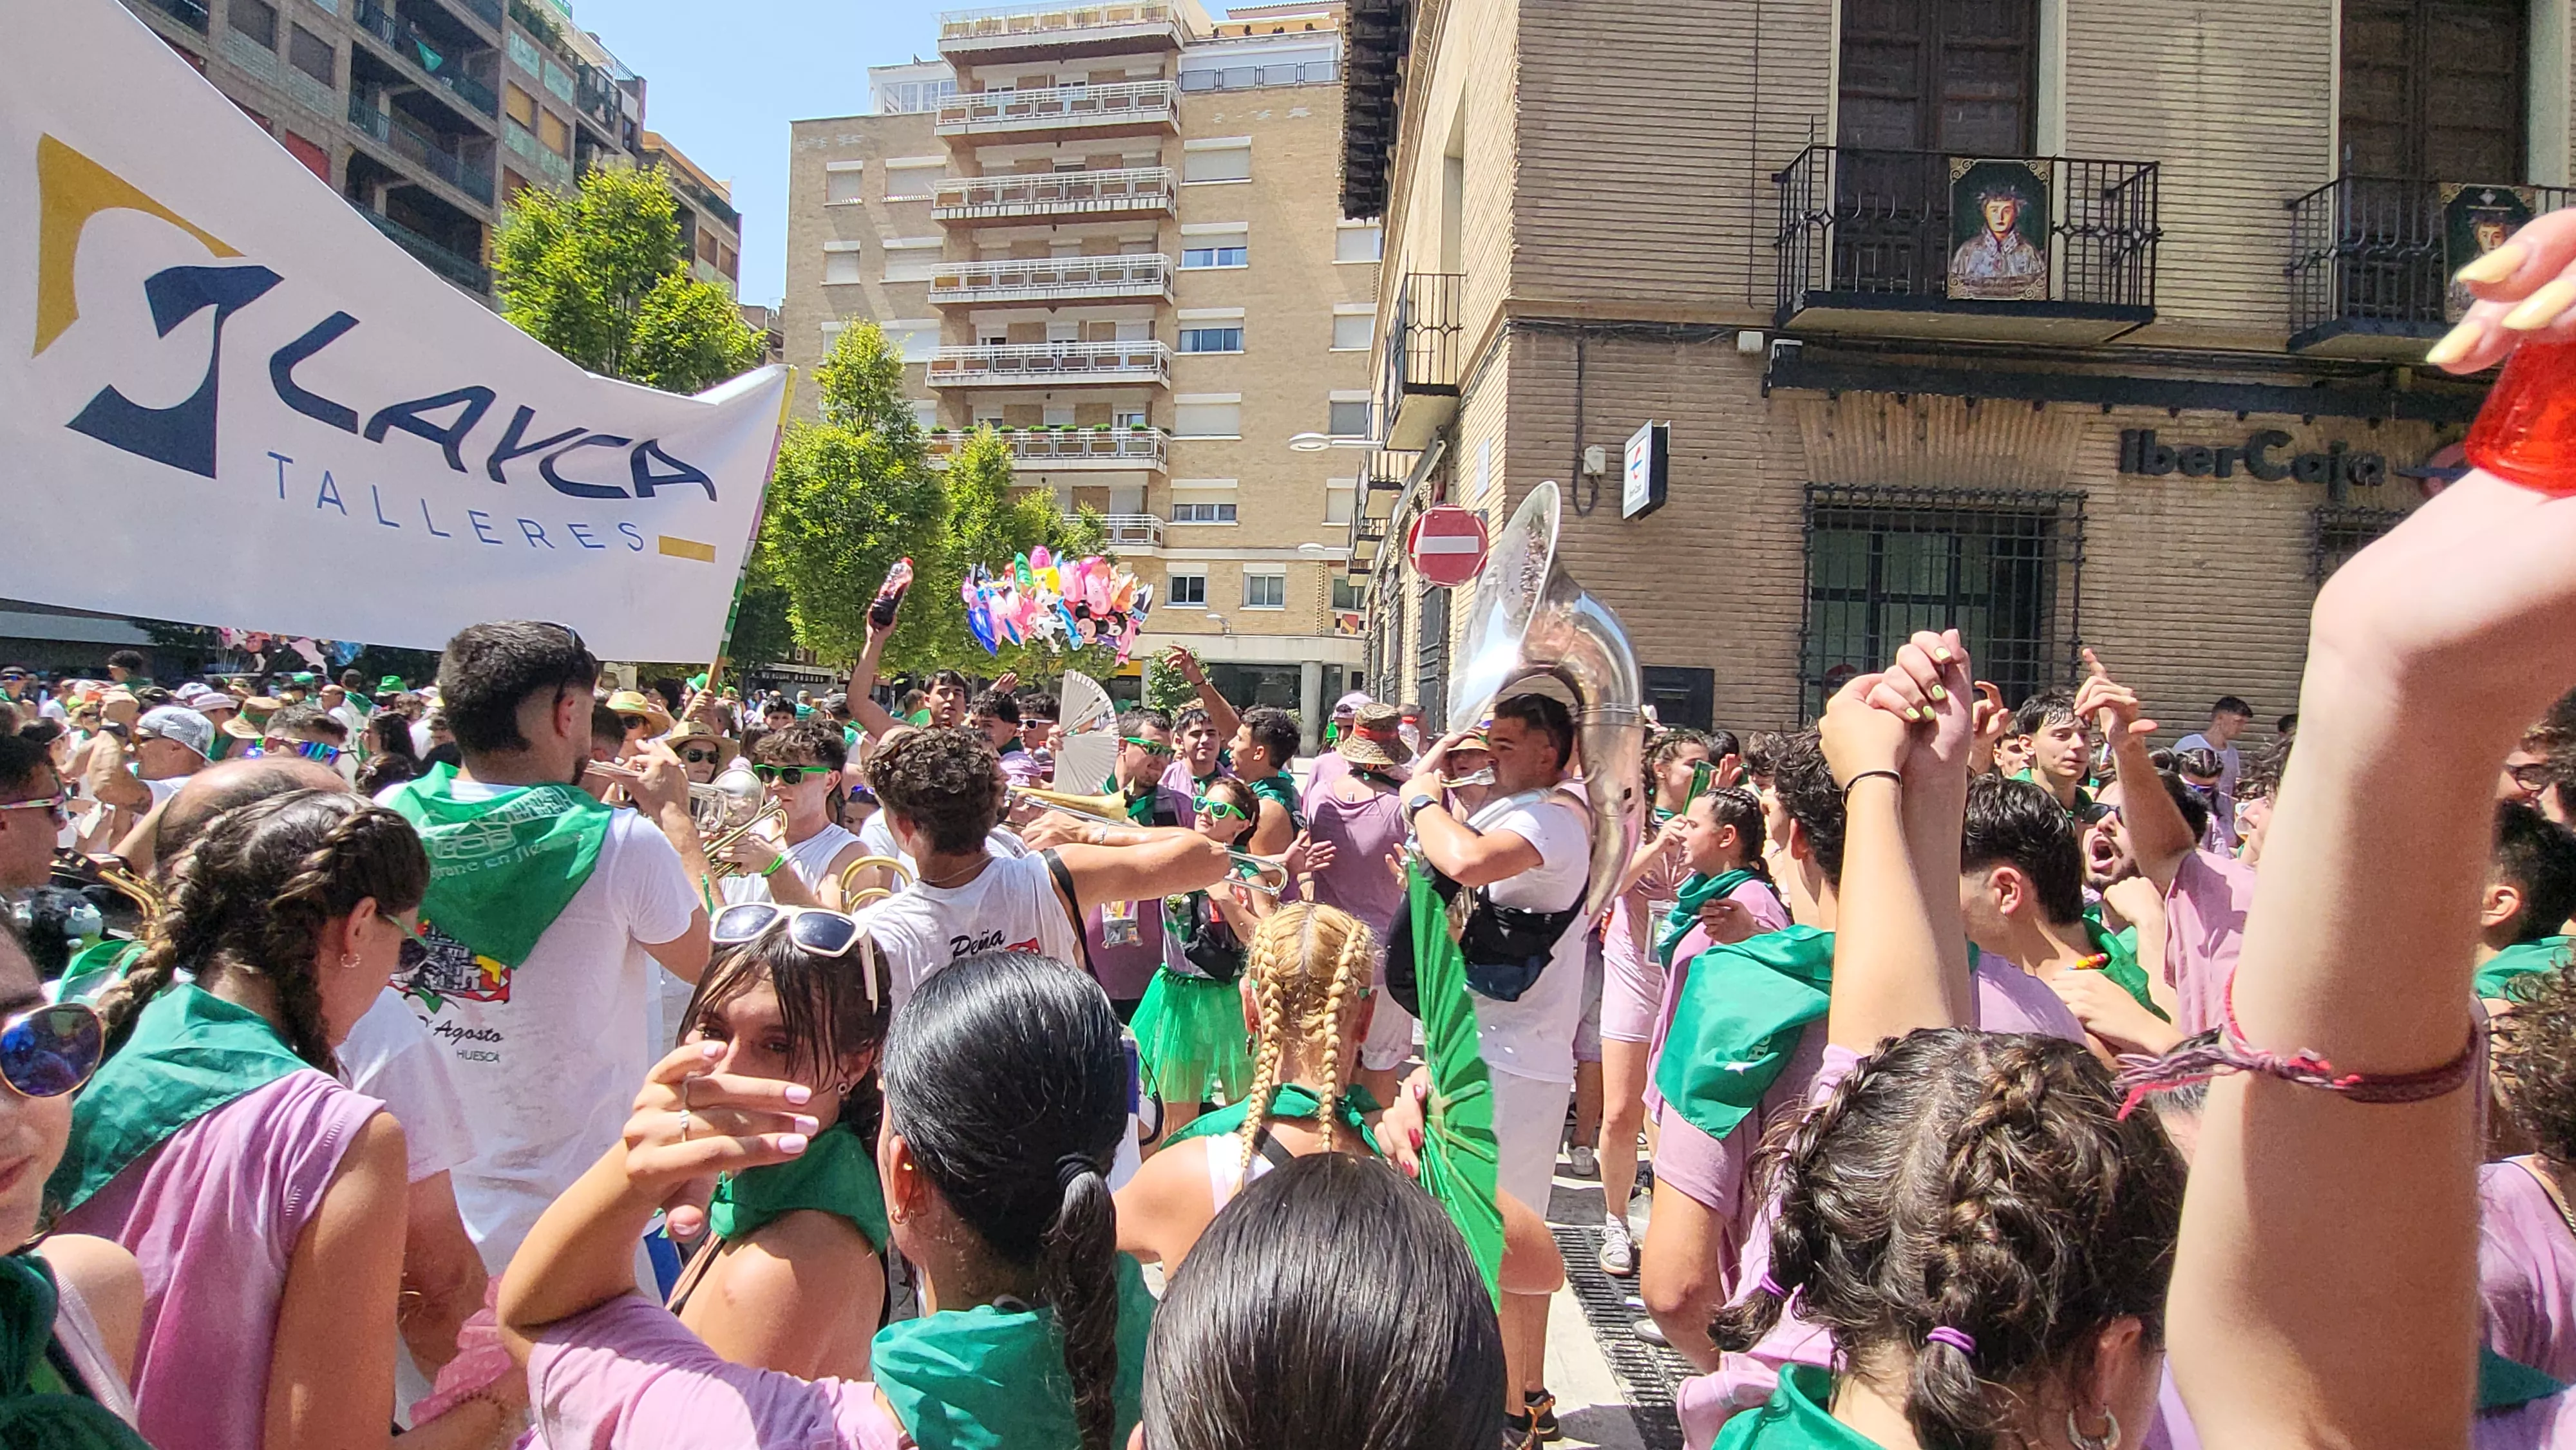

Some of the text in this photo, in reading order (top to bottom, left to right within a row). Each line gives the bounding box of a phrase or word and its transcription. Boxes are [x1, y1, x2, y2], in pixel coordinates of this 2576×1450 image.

[2118, 428, 2387, 502] IberCaja
[267, 451, 645, 552] TALLERES
[950, 928, 1006, 959] Peña
[457, 1049, 500, 1062] HUESCA
